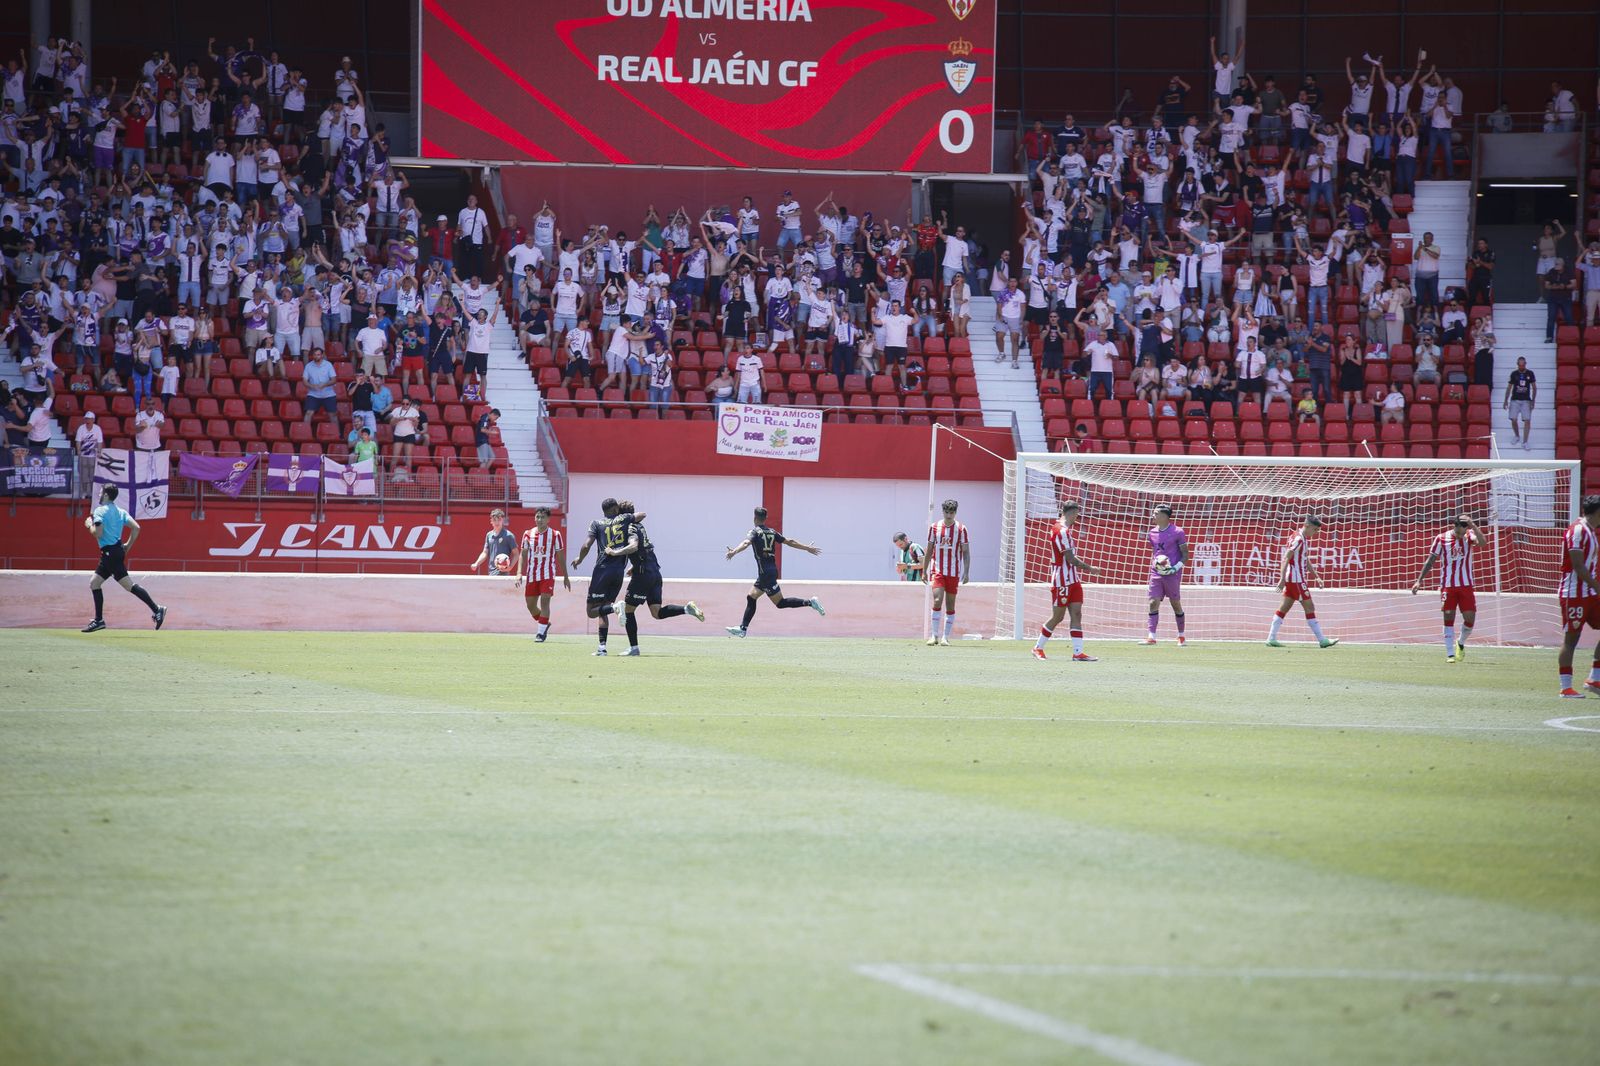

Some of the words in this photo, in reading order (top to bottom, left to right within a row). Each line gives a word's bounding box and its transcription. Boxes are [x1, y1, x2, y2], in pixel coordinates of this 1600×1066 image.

[699, 33, 717, 46] VS
[598, 54, 683, 83] REAL
[688, 51, 770, 86] JAÉN
[778, 60, 818, 87] CF
[938, 109, 974, 154] 0
[743, 406, 780, 416] Peña
[782, 410, 821, 419] AMIGOS
[743, 416, 761, 424] DEL
[604, 524, 625, 546] 15
[762, 533, 776, 551] 17
[1246, 546, 1364, 569] ALERIA
[1059, 586, 1069, 597] 21
[1568, 606, 1584, 619] 29
